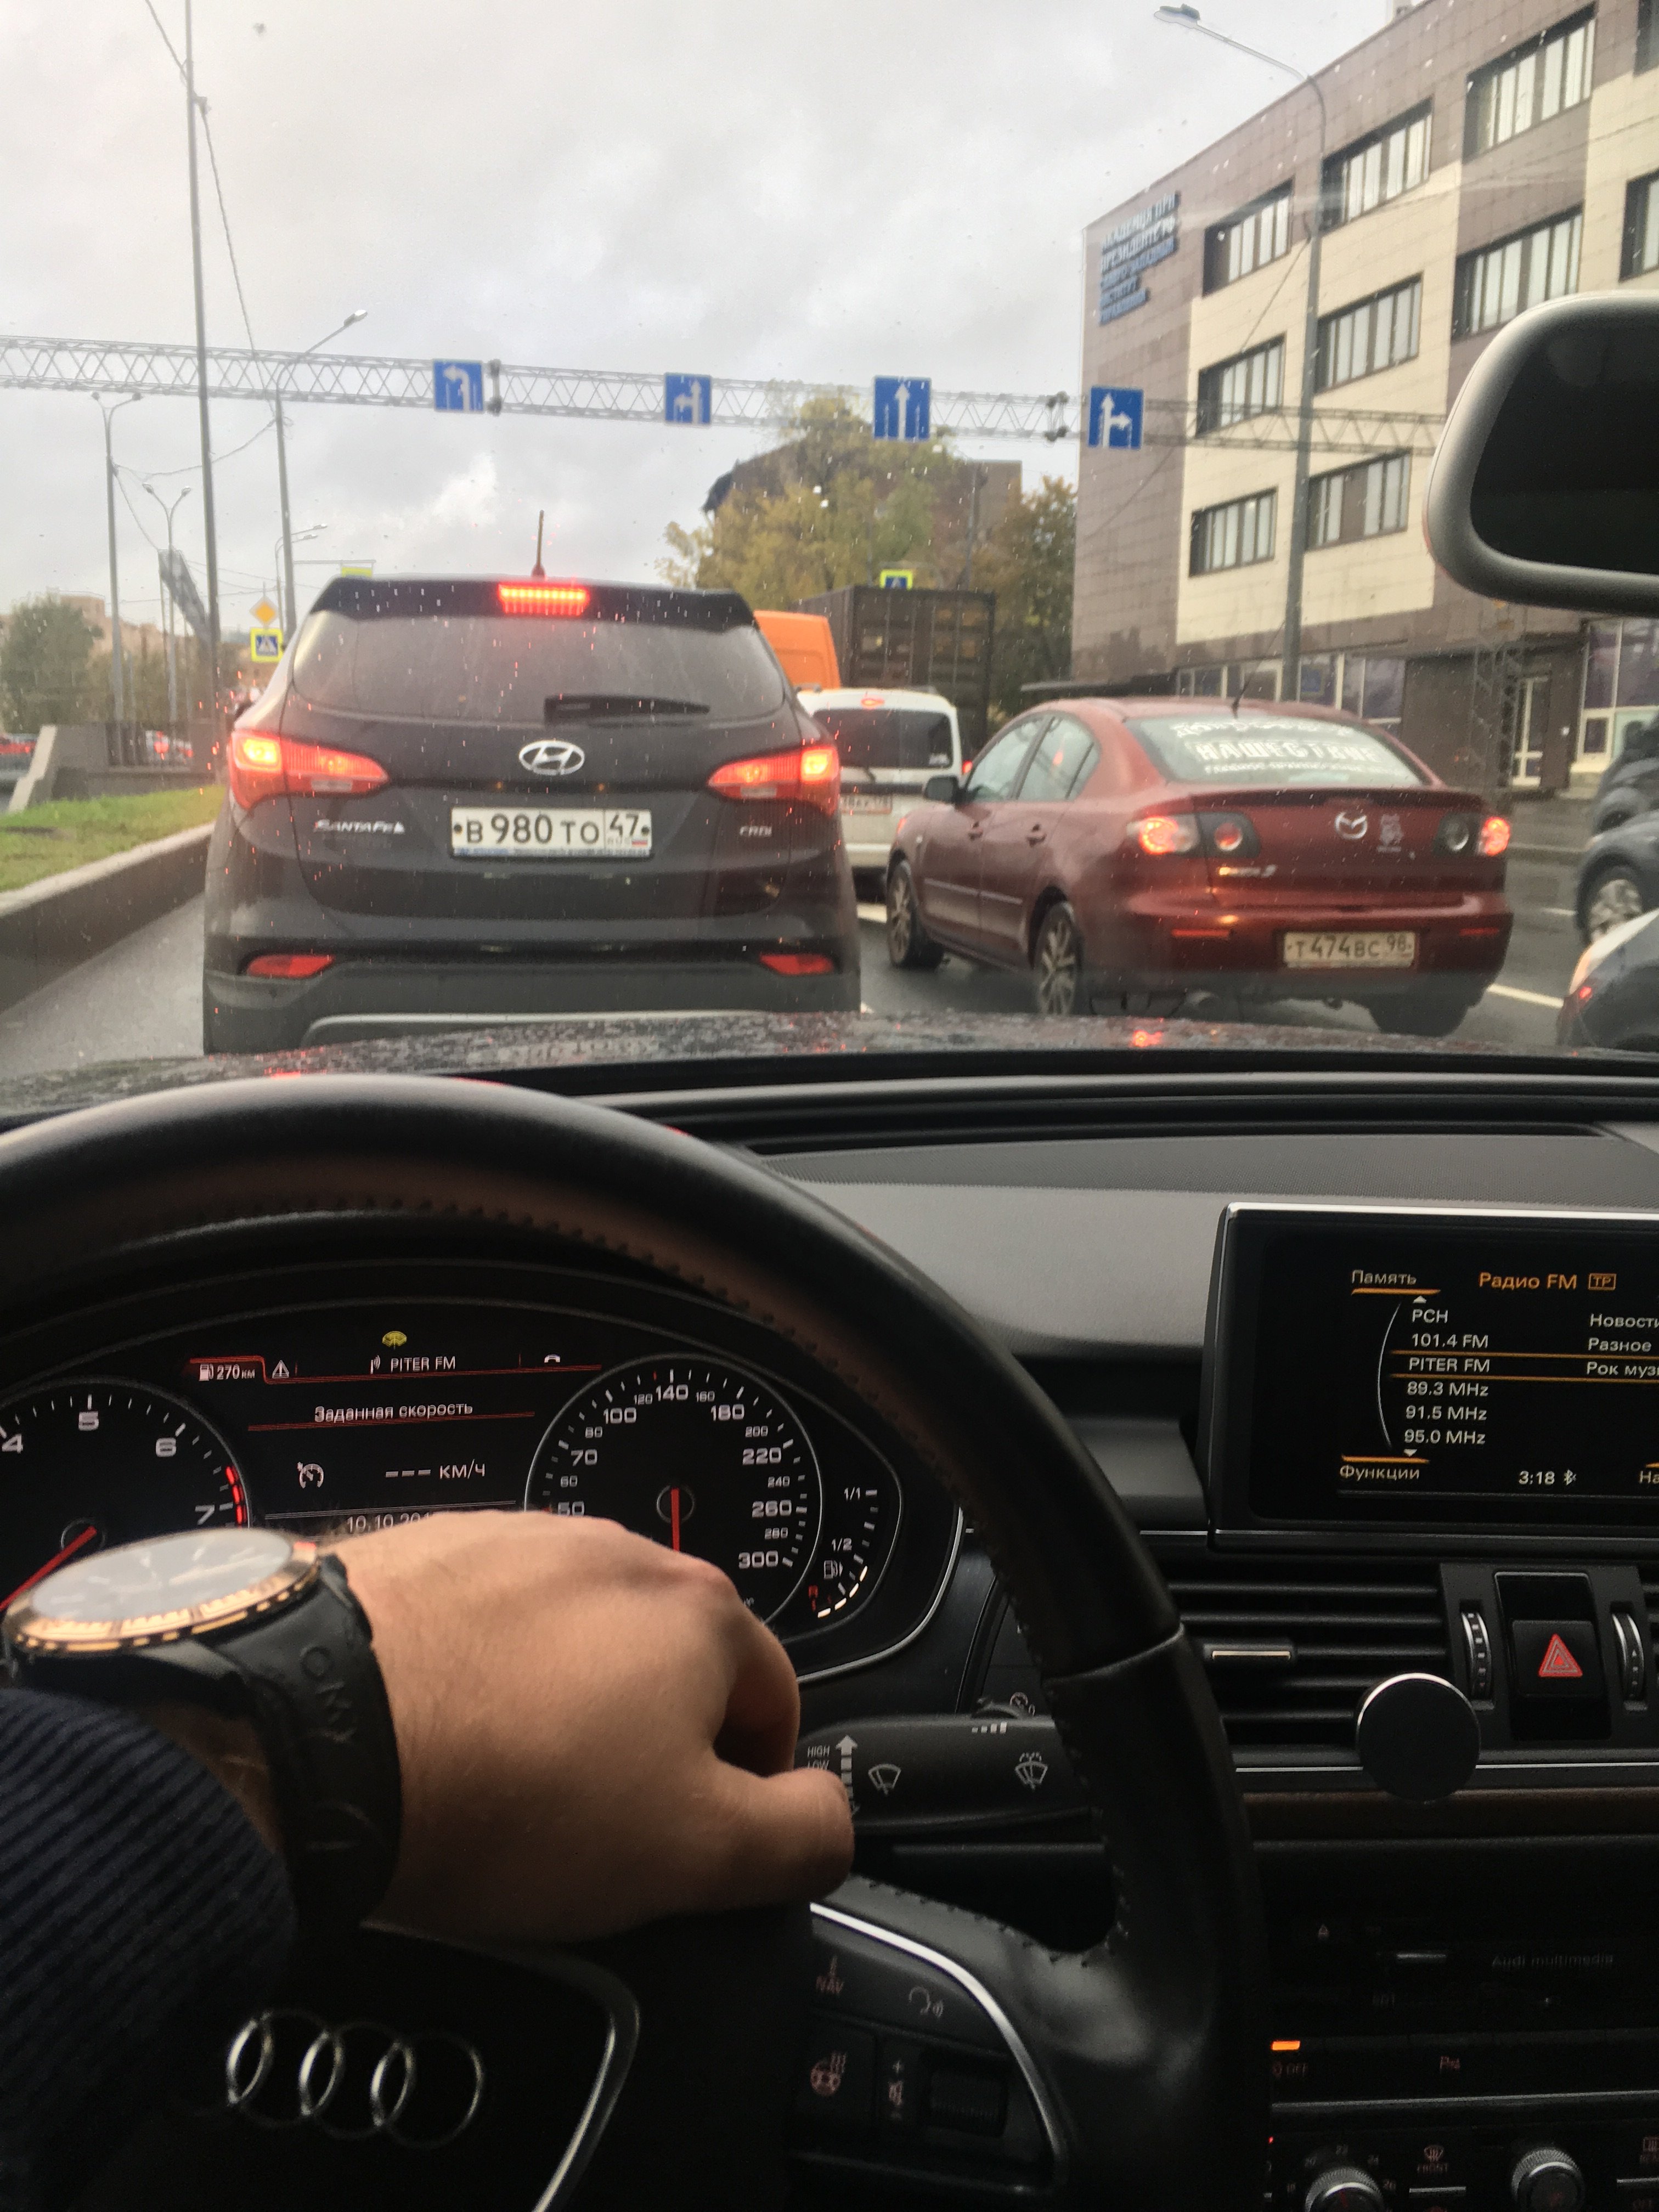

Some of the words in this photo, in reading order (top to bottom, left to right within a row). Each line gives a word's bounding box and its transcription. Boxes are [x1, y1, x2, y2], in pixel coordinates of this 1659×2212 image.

[1351, 1269, 1417, 1285] Память
[1479, 1272, 1541, 1290] Радио
[1547, 1274, 1577, 1289] FM
[1412, 1333, 1458, 1347] 101.4
[1463, 1334, 1488, 1348] FM
[1588, 1338, 1652, 1352] Разное
[217, 1364, 240, 1380] 270
[391, 1357, 430, 1373] PITER
[435, 1356, 456, 1370] FM
[1409, 1357, 1458, 1372] PITER
[1464, 1358, 1491, 1373] FM
[1587, 1362, 1618, 1375] Рок
[1624, 1365, 1659, 1379] муз
[656, 1384, 689, 1402] 140
[1407, 1381, 1444, 1396] 89.3
[1449, 1382, 1489, 1397] MHz
[78, 1410, 99, 1431] 5
[314, 1406, 393, 1424] Заданная
[399, 1403, 473, 1420] скорость
[603, 1407, 637, 1424] 100
[711, 1403, 745, 1421] 180
[1406, 1405, 1442, 1420] 91.5
[1447, 1406, 1488, 1421] MHz
[745, 1425, 769, 1438] 200
[1404, 1429, 1441, 1444] 95.0
[1446, 1430, 1486, 1444] MHz
[2, 1433, 23, 1453] 4
[156, 1437, 176, 1457] 6
[571, 1449, 598, 1466] 70
[742, 1447, 782, 1466] 220
[560, 1475, 578, 1487] 60
[1340, 1464, 1420, 1481] Функции
[1519, 1470, 1555, 1486] 3:18
[768, 1476, 790, 1488] 240
[844, 1486, 861, 1502] 1/1
[195, 1504, 215, 1525] 7
[752, 1499, 792, 1518] 260
[831, 1537, 853, 1551] 1/2
[738, 1550, 779, 1569] 300
[807, 1745, 830, 1757] HIGH
